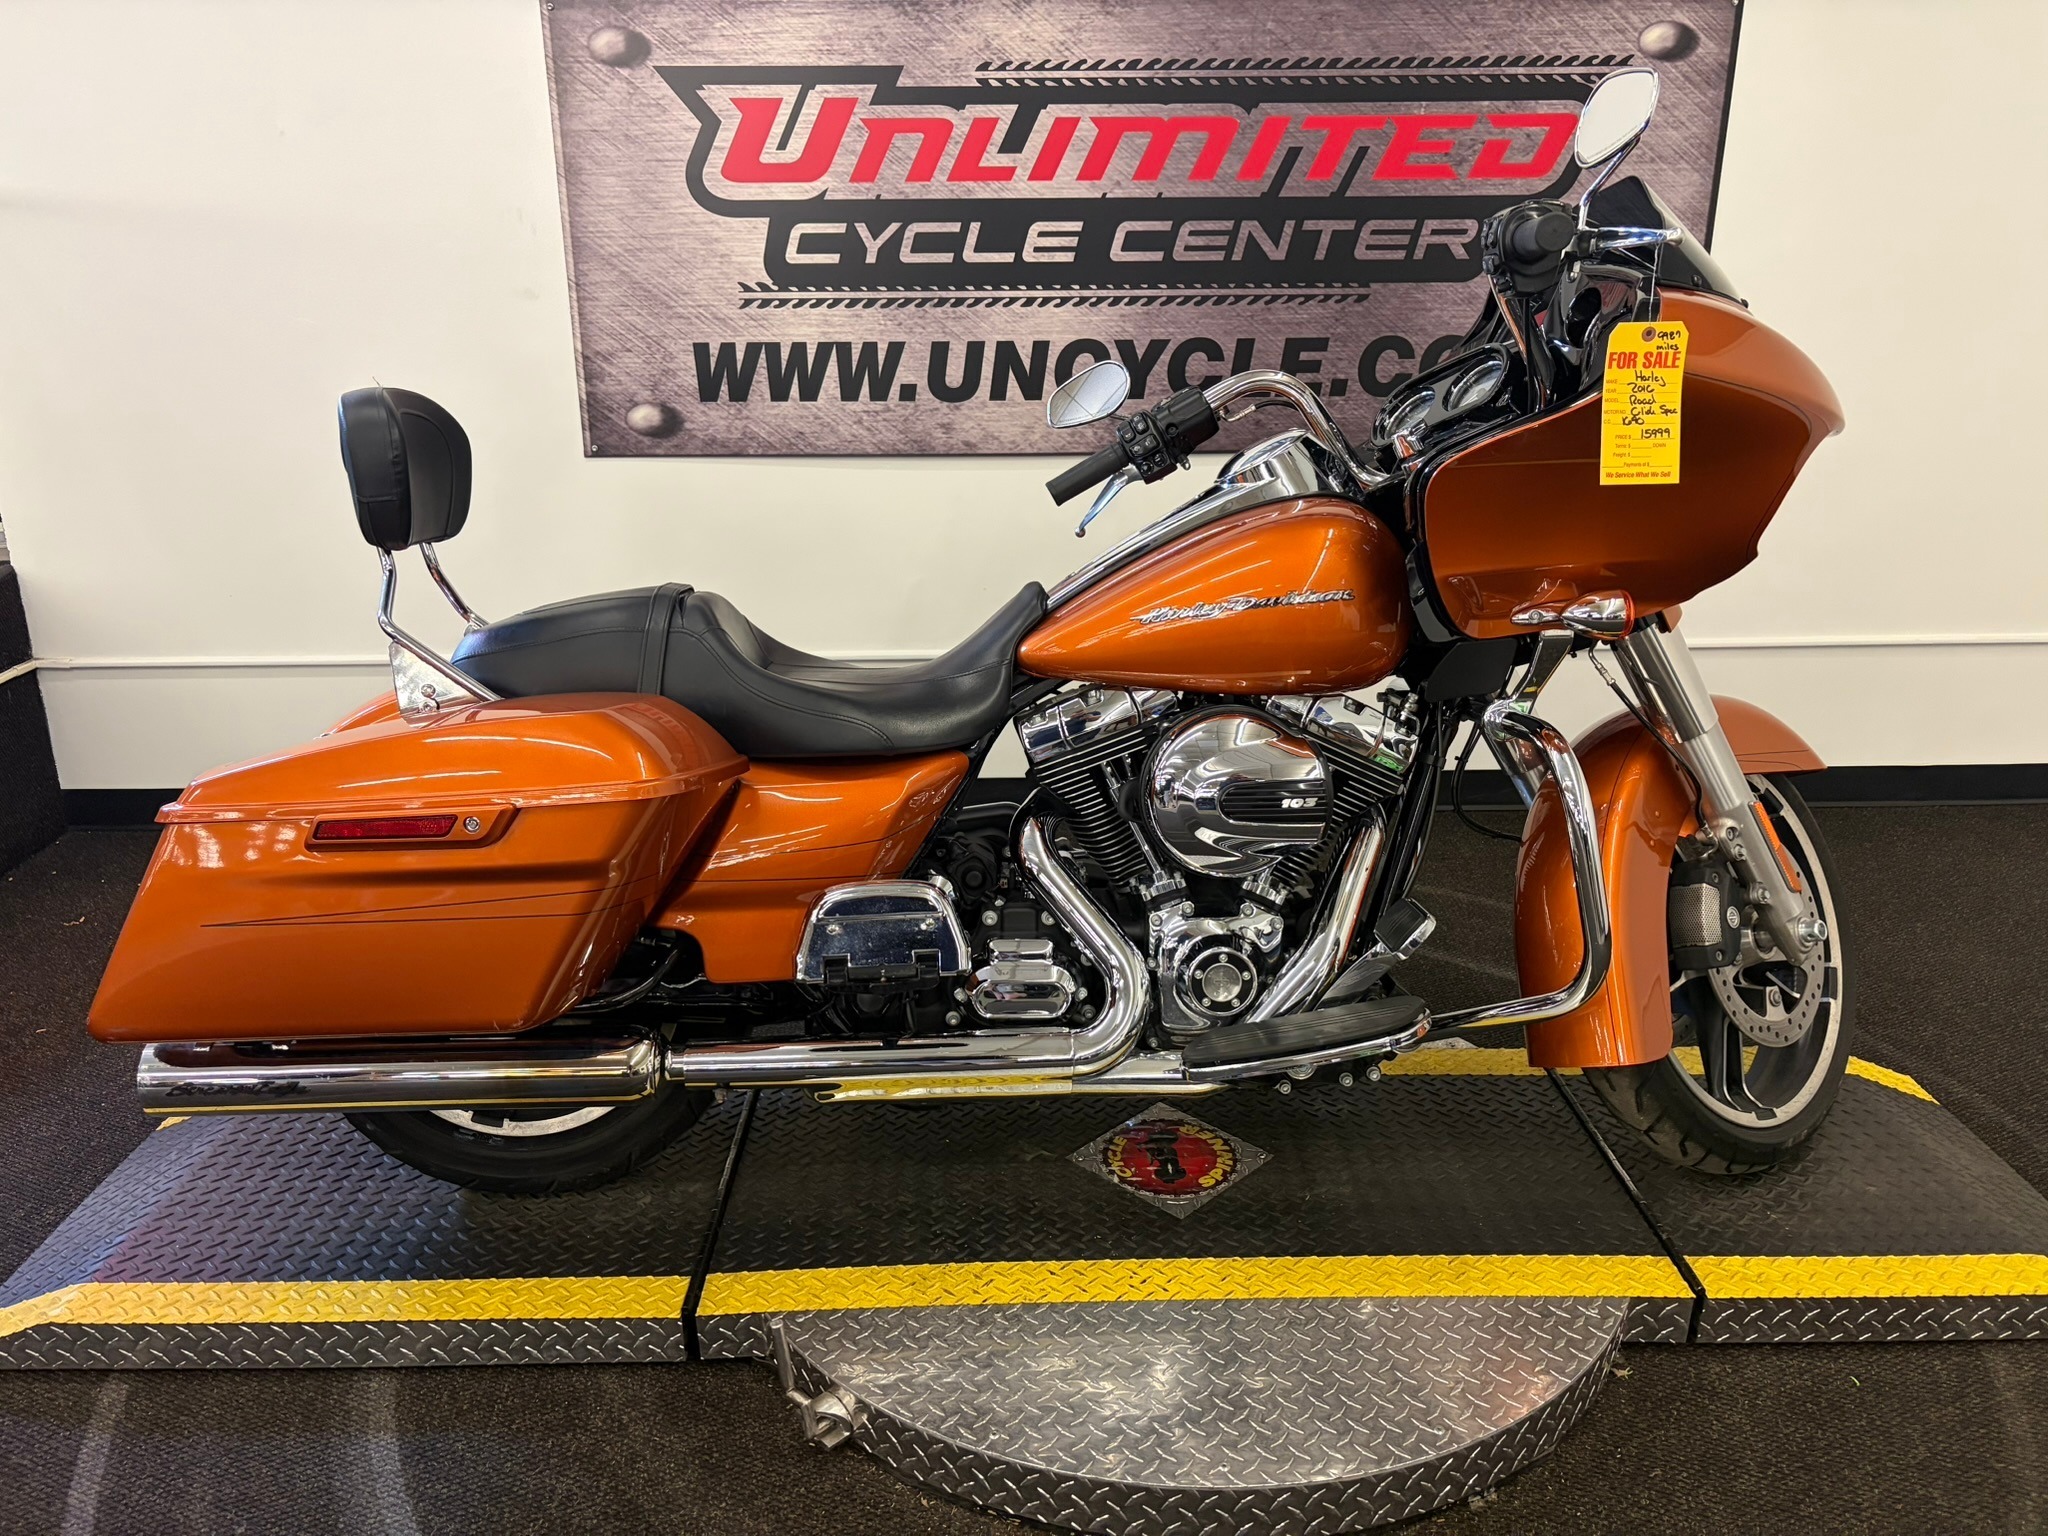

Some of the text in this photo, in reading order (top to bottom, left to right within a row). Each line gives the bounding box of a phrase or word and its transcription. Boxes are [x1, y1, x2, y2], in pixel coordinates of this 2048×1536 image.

[785, 218, 1479, 265] CYCLE CENTER
[1656, 342, 1679, 351] miles
[1607, 351, 1681, 370] FOR SALE
[1634, 370, 1666, 387] Harley
[1629, 393, 1657, 406] Road
[1640, 428, 1671, 439] 15999
[1281, 797, 1319, 809] 103
[1107, 1135, 1133, 1178] CYCLE
[1178, 1123, 1234, 1188] SPINNER
